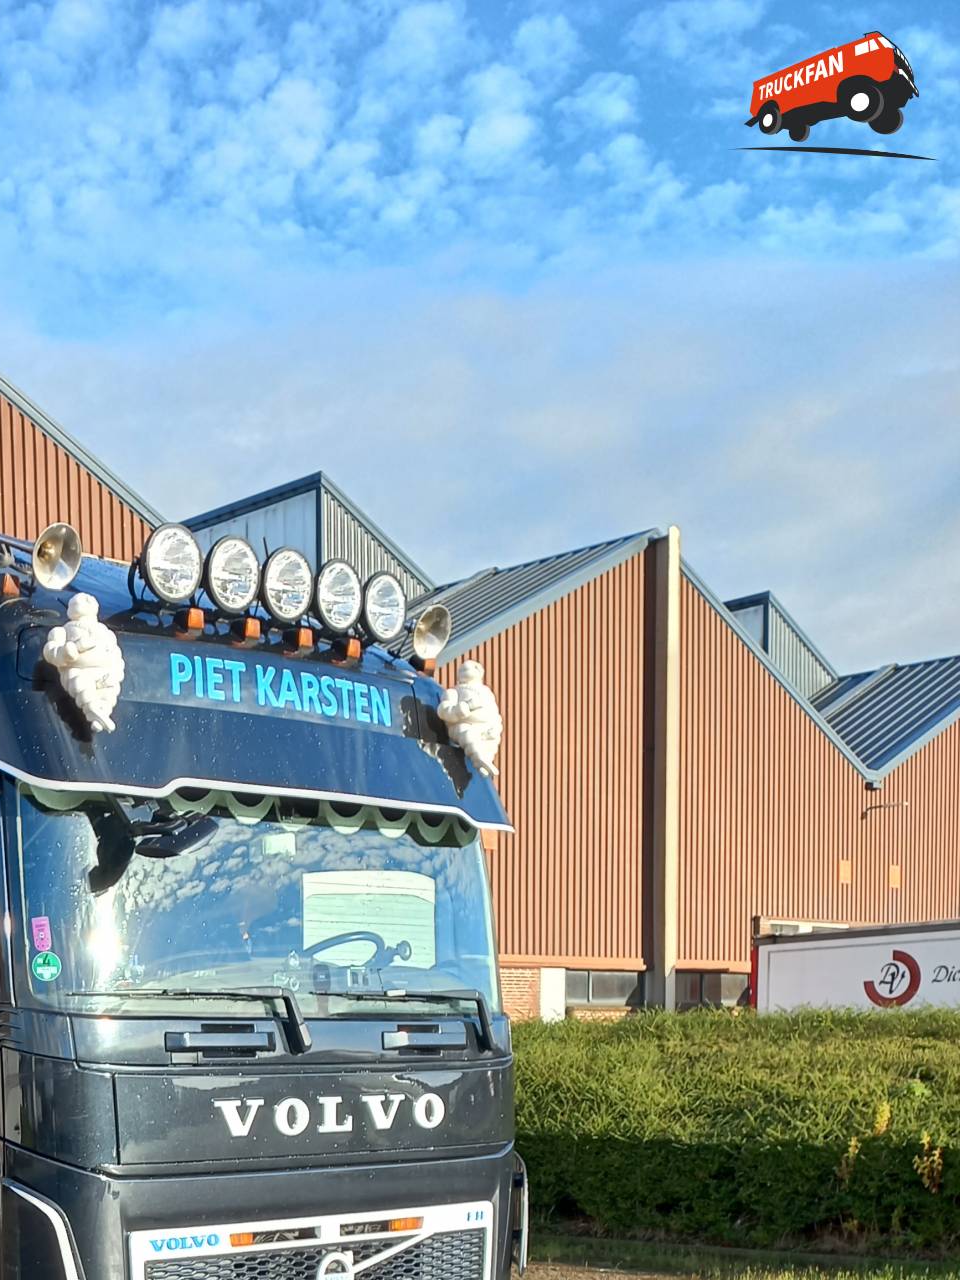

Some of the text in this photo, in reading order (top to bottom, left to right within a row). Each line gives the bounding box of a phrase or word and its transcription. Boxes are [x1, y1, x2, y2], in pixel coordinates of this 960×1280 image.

[170, 652, 392, 727] PIET KARSTEN
[213, 1092, 446, 1137] VOLVO
[149, 1233, 220, 1252] VOLVO
